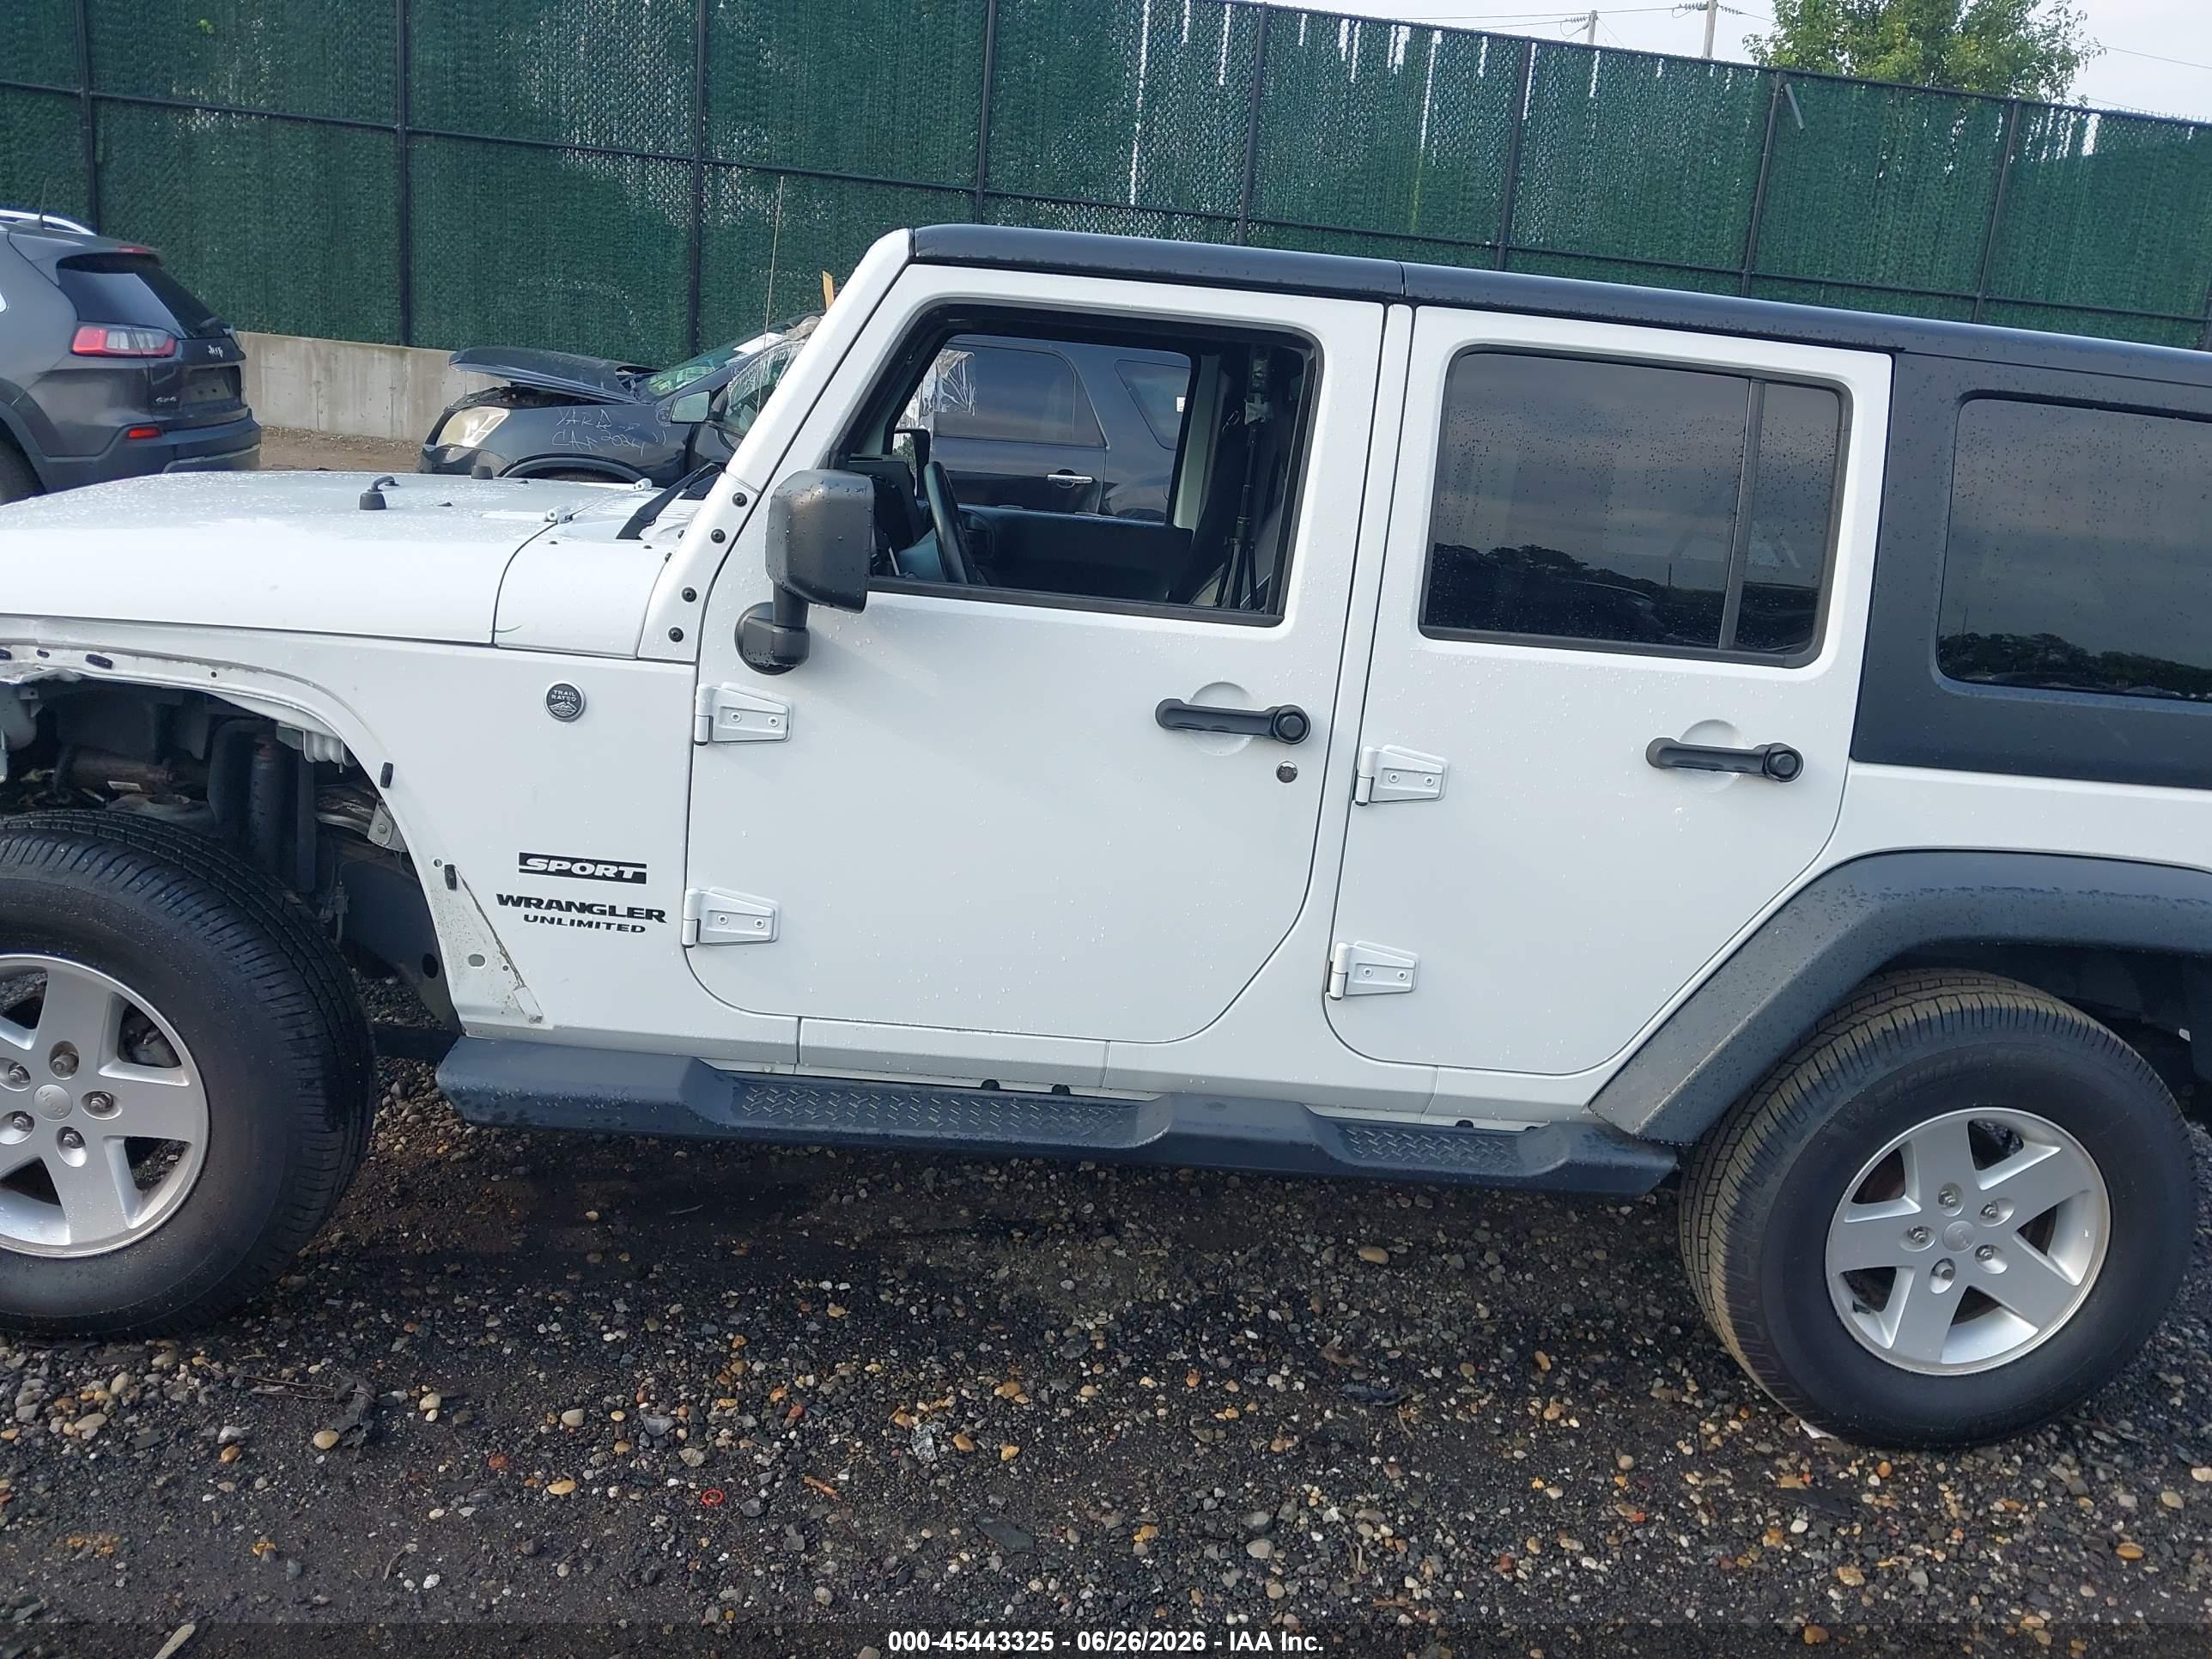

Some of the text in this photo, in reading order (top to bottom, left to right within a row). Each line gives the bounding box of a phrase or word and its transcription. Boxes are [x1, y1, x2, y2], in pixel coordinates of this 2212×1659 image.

[556, 408, 612, 428] YARD
[519, 857, 647, 879] SPORT
[495, 893, 667, 923] WRANGLER
[523, 914, 646, 933] UNLIMITED
